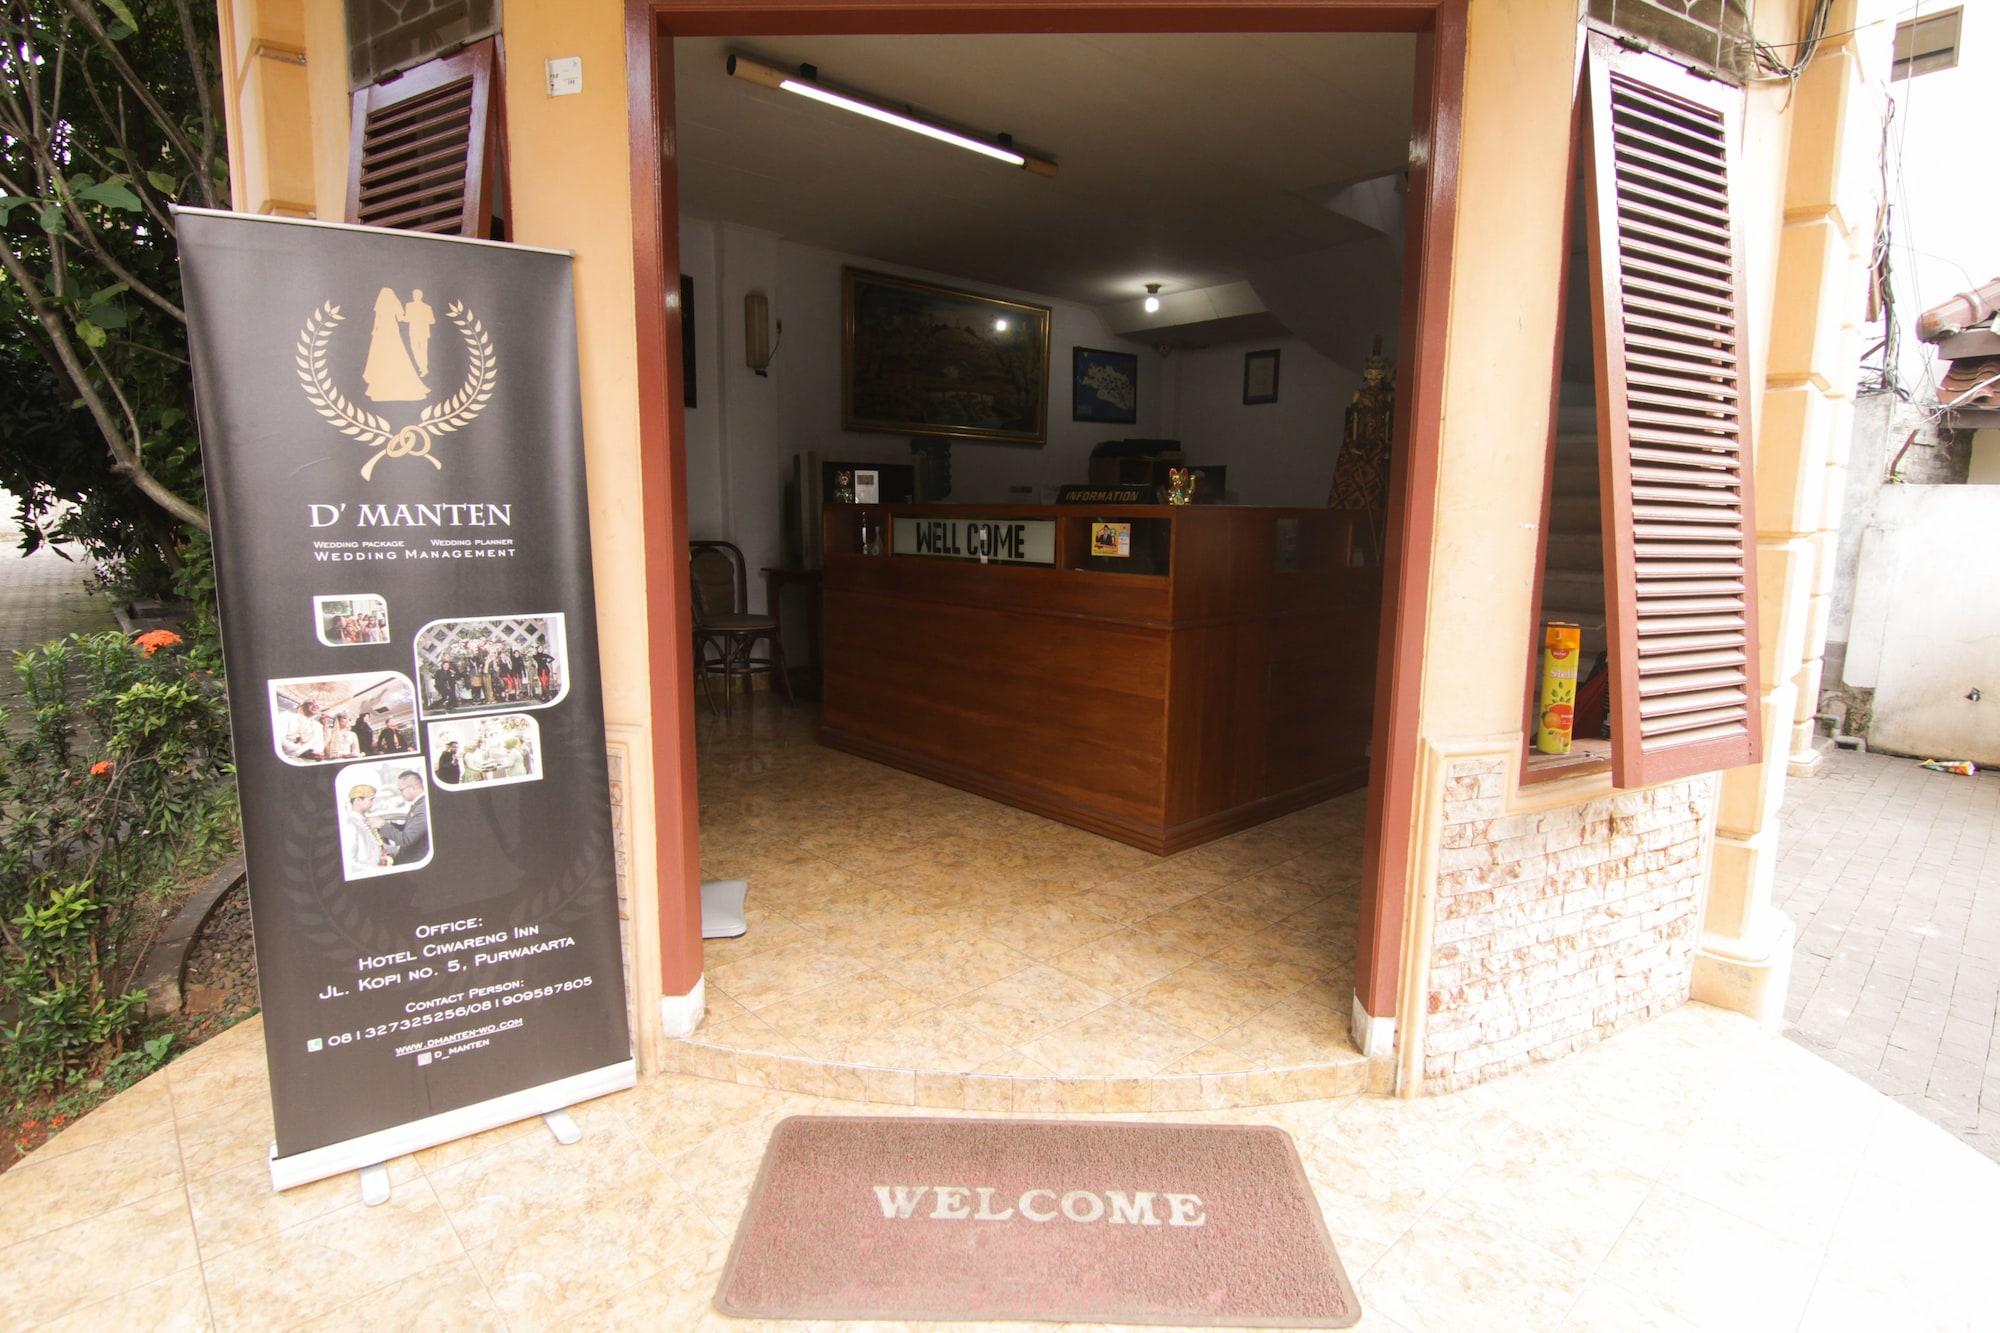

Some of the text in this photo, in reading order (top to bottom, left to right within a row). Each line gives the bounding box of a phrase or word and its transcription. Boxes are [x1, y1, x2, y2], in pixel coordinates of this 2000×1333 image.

[1065, 490, 1139, 502] INFORMATION
[308, 502, 512, 528] D' MANTEN
[916, 522, 1025, 559] WELL COME
[447, 960, 467, 972] 5,
[873, 1185, 1206, 1227] WELCOME
